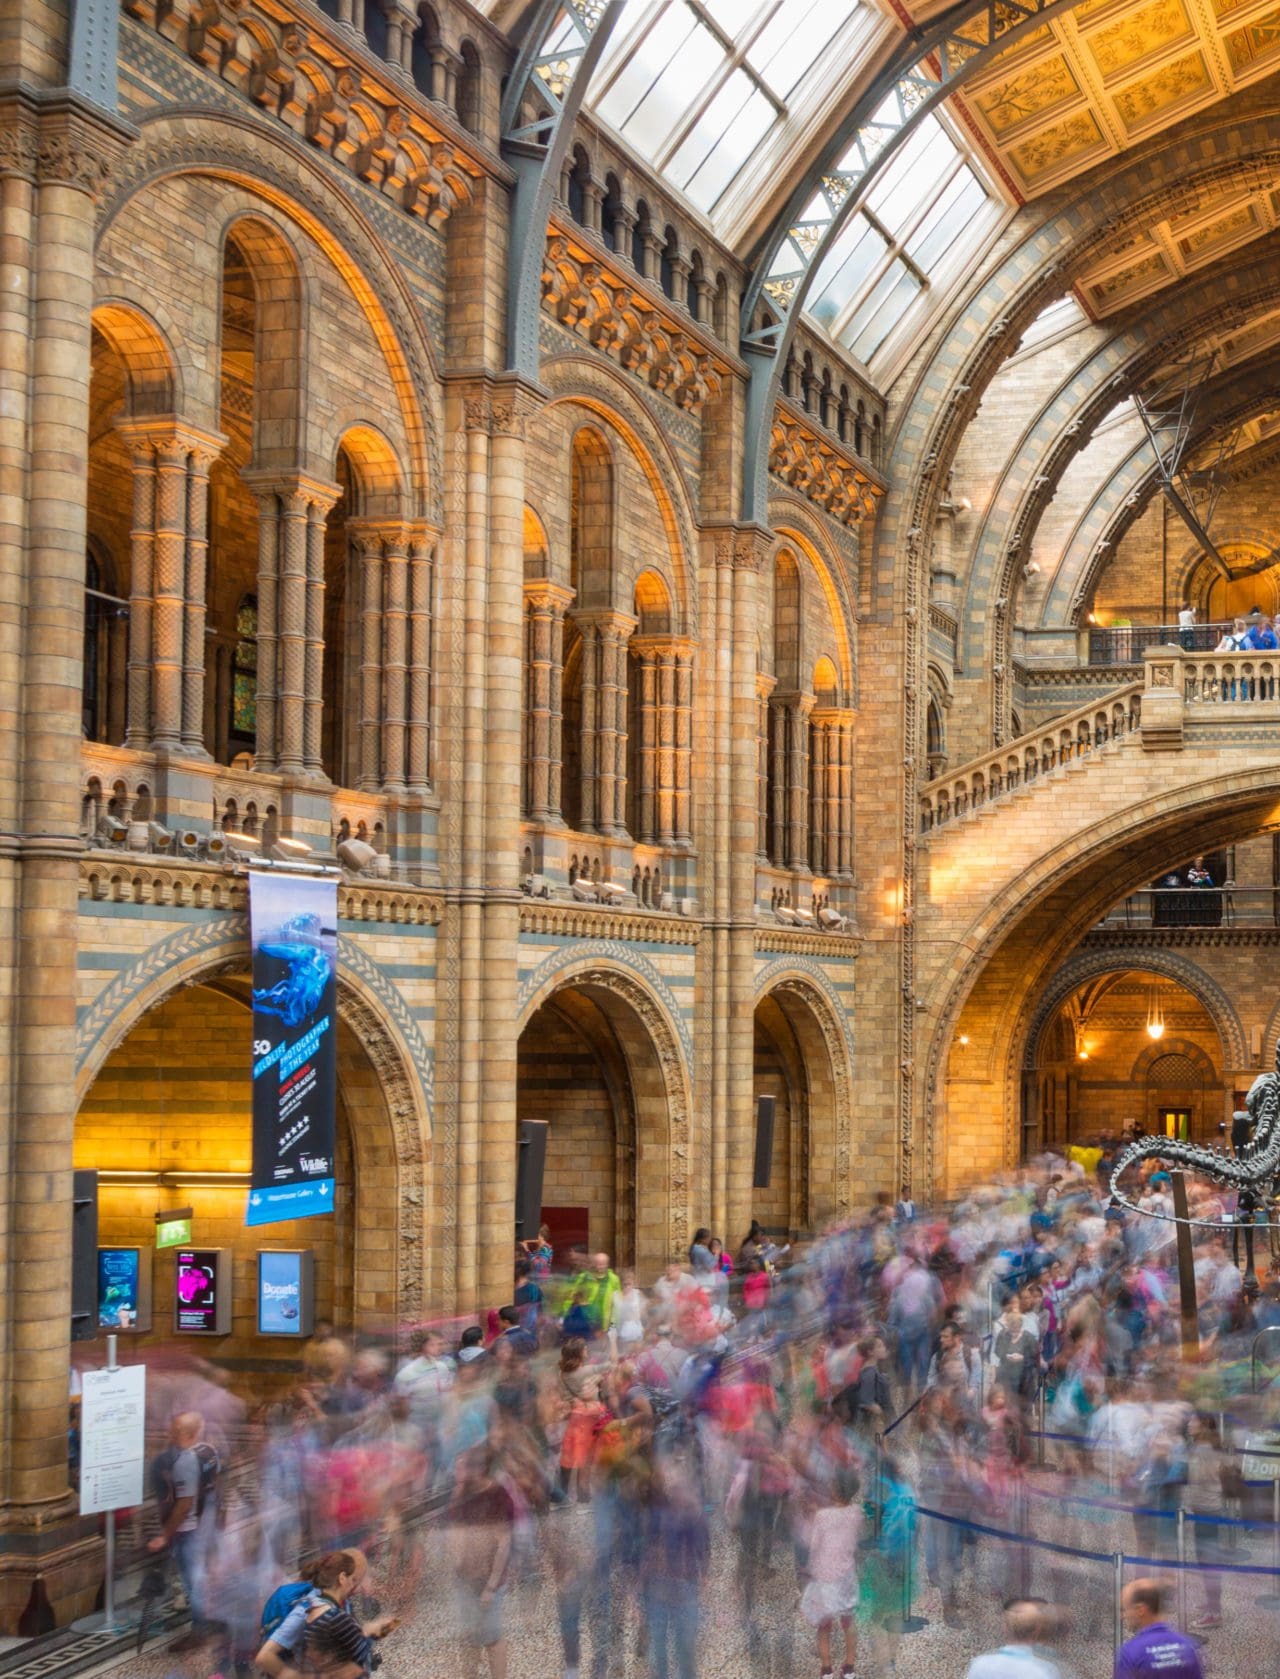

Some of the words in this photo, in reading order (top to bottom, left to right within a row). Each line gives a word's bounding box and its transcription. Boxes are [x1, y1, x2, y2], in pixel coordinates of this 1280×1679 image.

[253, 1040, 271, 1055] 50
[280, 1015, 329, 1066] PHOTOGRAPHER
[288, 1055, 303, 1073] THE
[304, 1038, 320, 1060] YEAR
[253, 1041, 286, 1078] WILDLIFE
[263, 1282, 298, 1295] Donate
